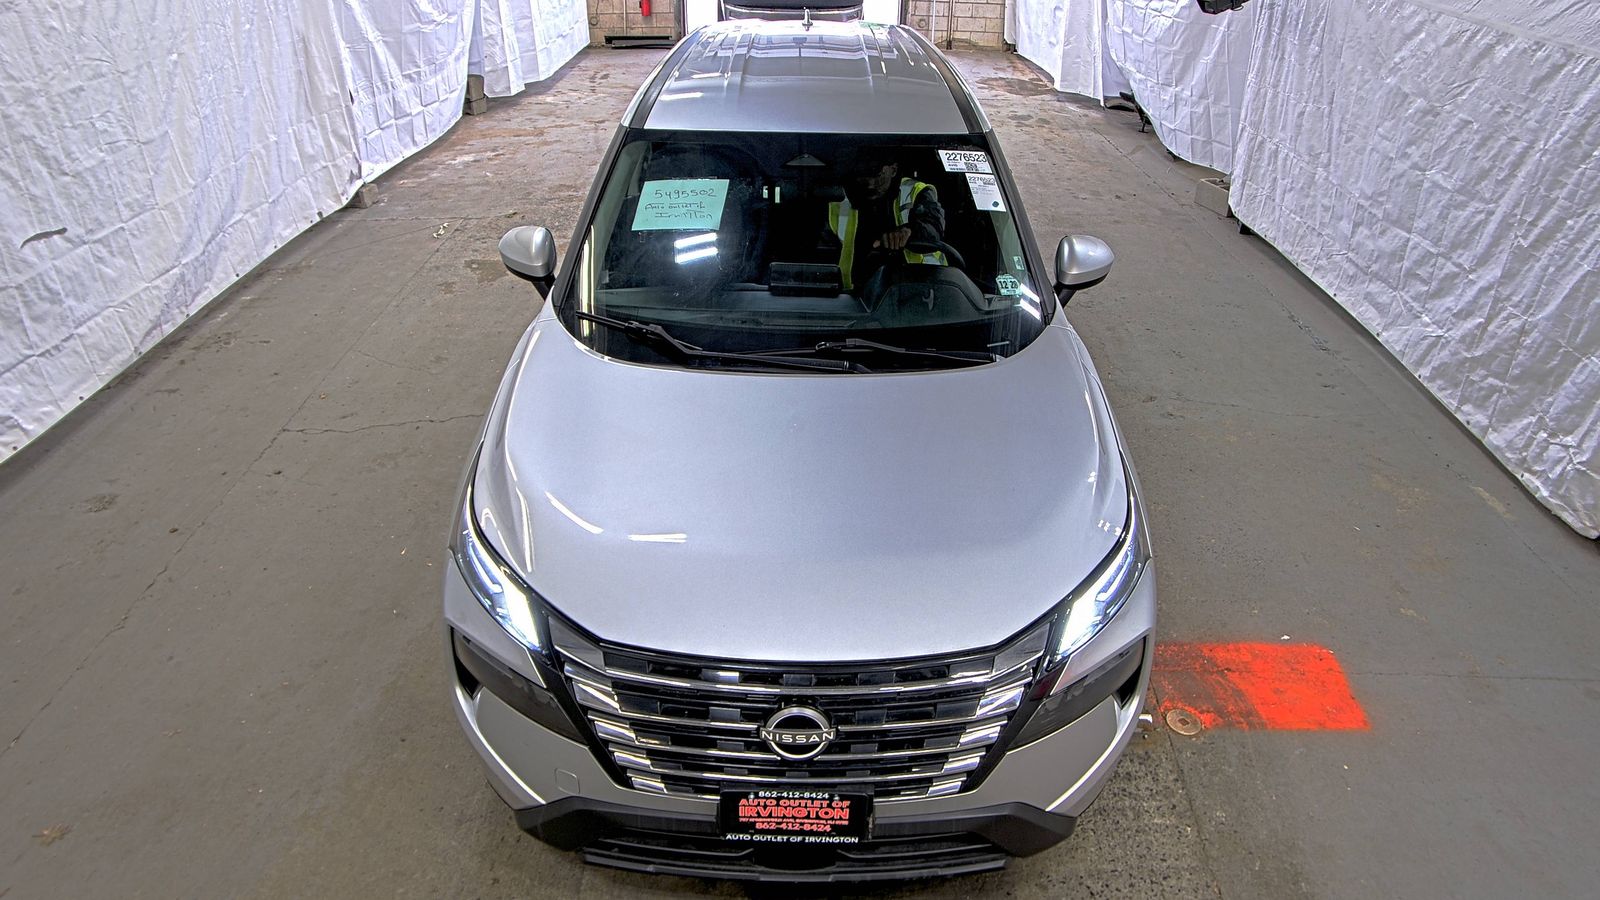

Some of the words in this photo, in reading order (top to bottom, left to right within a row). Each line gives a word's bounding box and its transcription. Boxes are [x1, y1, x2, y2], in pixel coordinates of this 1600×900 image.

[945, 152, 987, 162] 2276523
[655, 188, 717, 199] 5495502
[761, 730, 834, 743] NISSAN
[758, 791, 829, 799] 862-412-8424
[739, 799, 777, 807] AUTO
[779, 800, 829, 808] OUTLET
[831, 800, 851, 808] OF
[738, 806, 850, 820] IRVINGTON
[755, 822, 832, 832] 862-412-8424
[752, 834, 788, 842] OUTLET
[789, 835, 803, 843] OF
[804, 836, 859, 844] IRVINGTON
